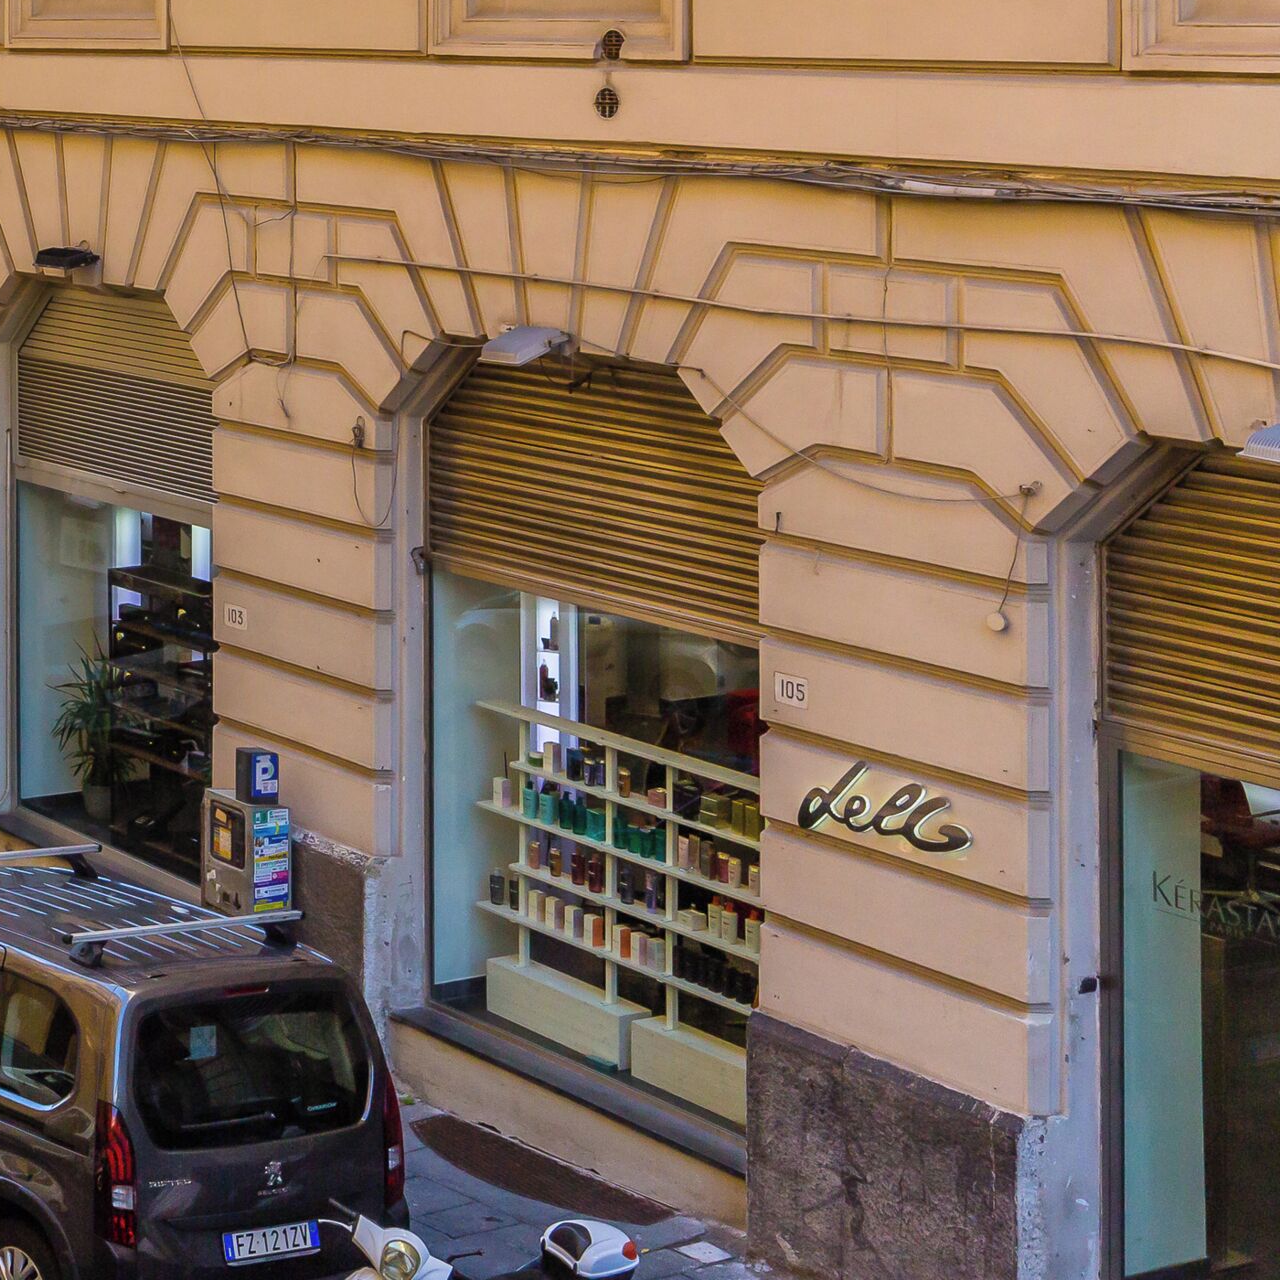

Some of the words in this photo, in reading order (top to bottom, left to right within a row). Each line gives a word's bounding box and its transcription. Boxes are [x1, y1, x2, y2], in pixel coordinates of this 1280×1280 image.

[227, 607, 244, 625] 103
[780, 678, 806, 702] 105
[1151, 869, 1280, 940] KÉRASTA
[235, 1233, 257, 1257] FZ
[261, 1227, 309, 1255] 121ZV
